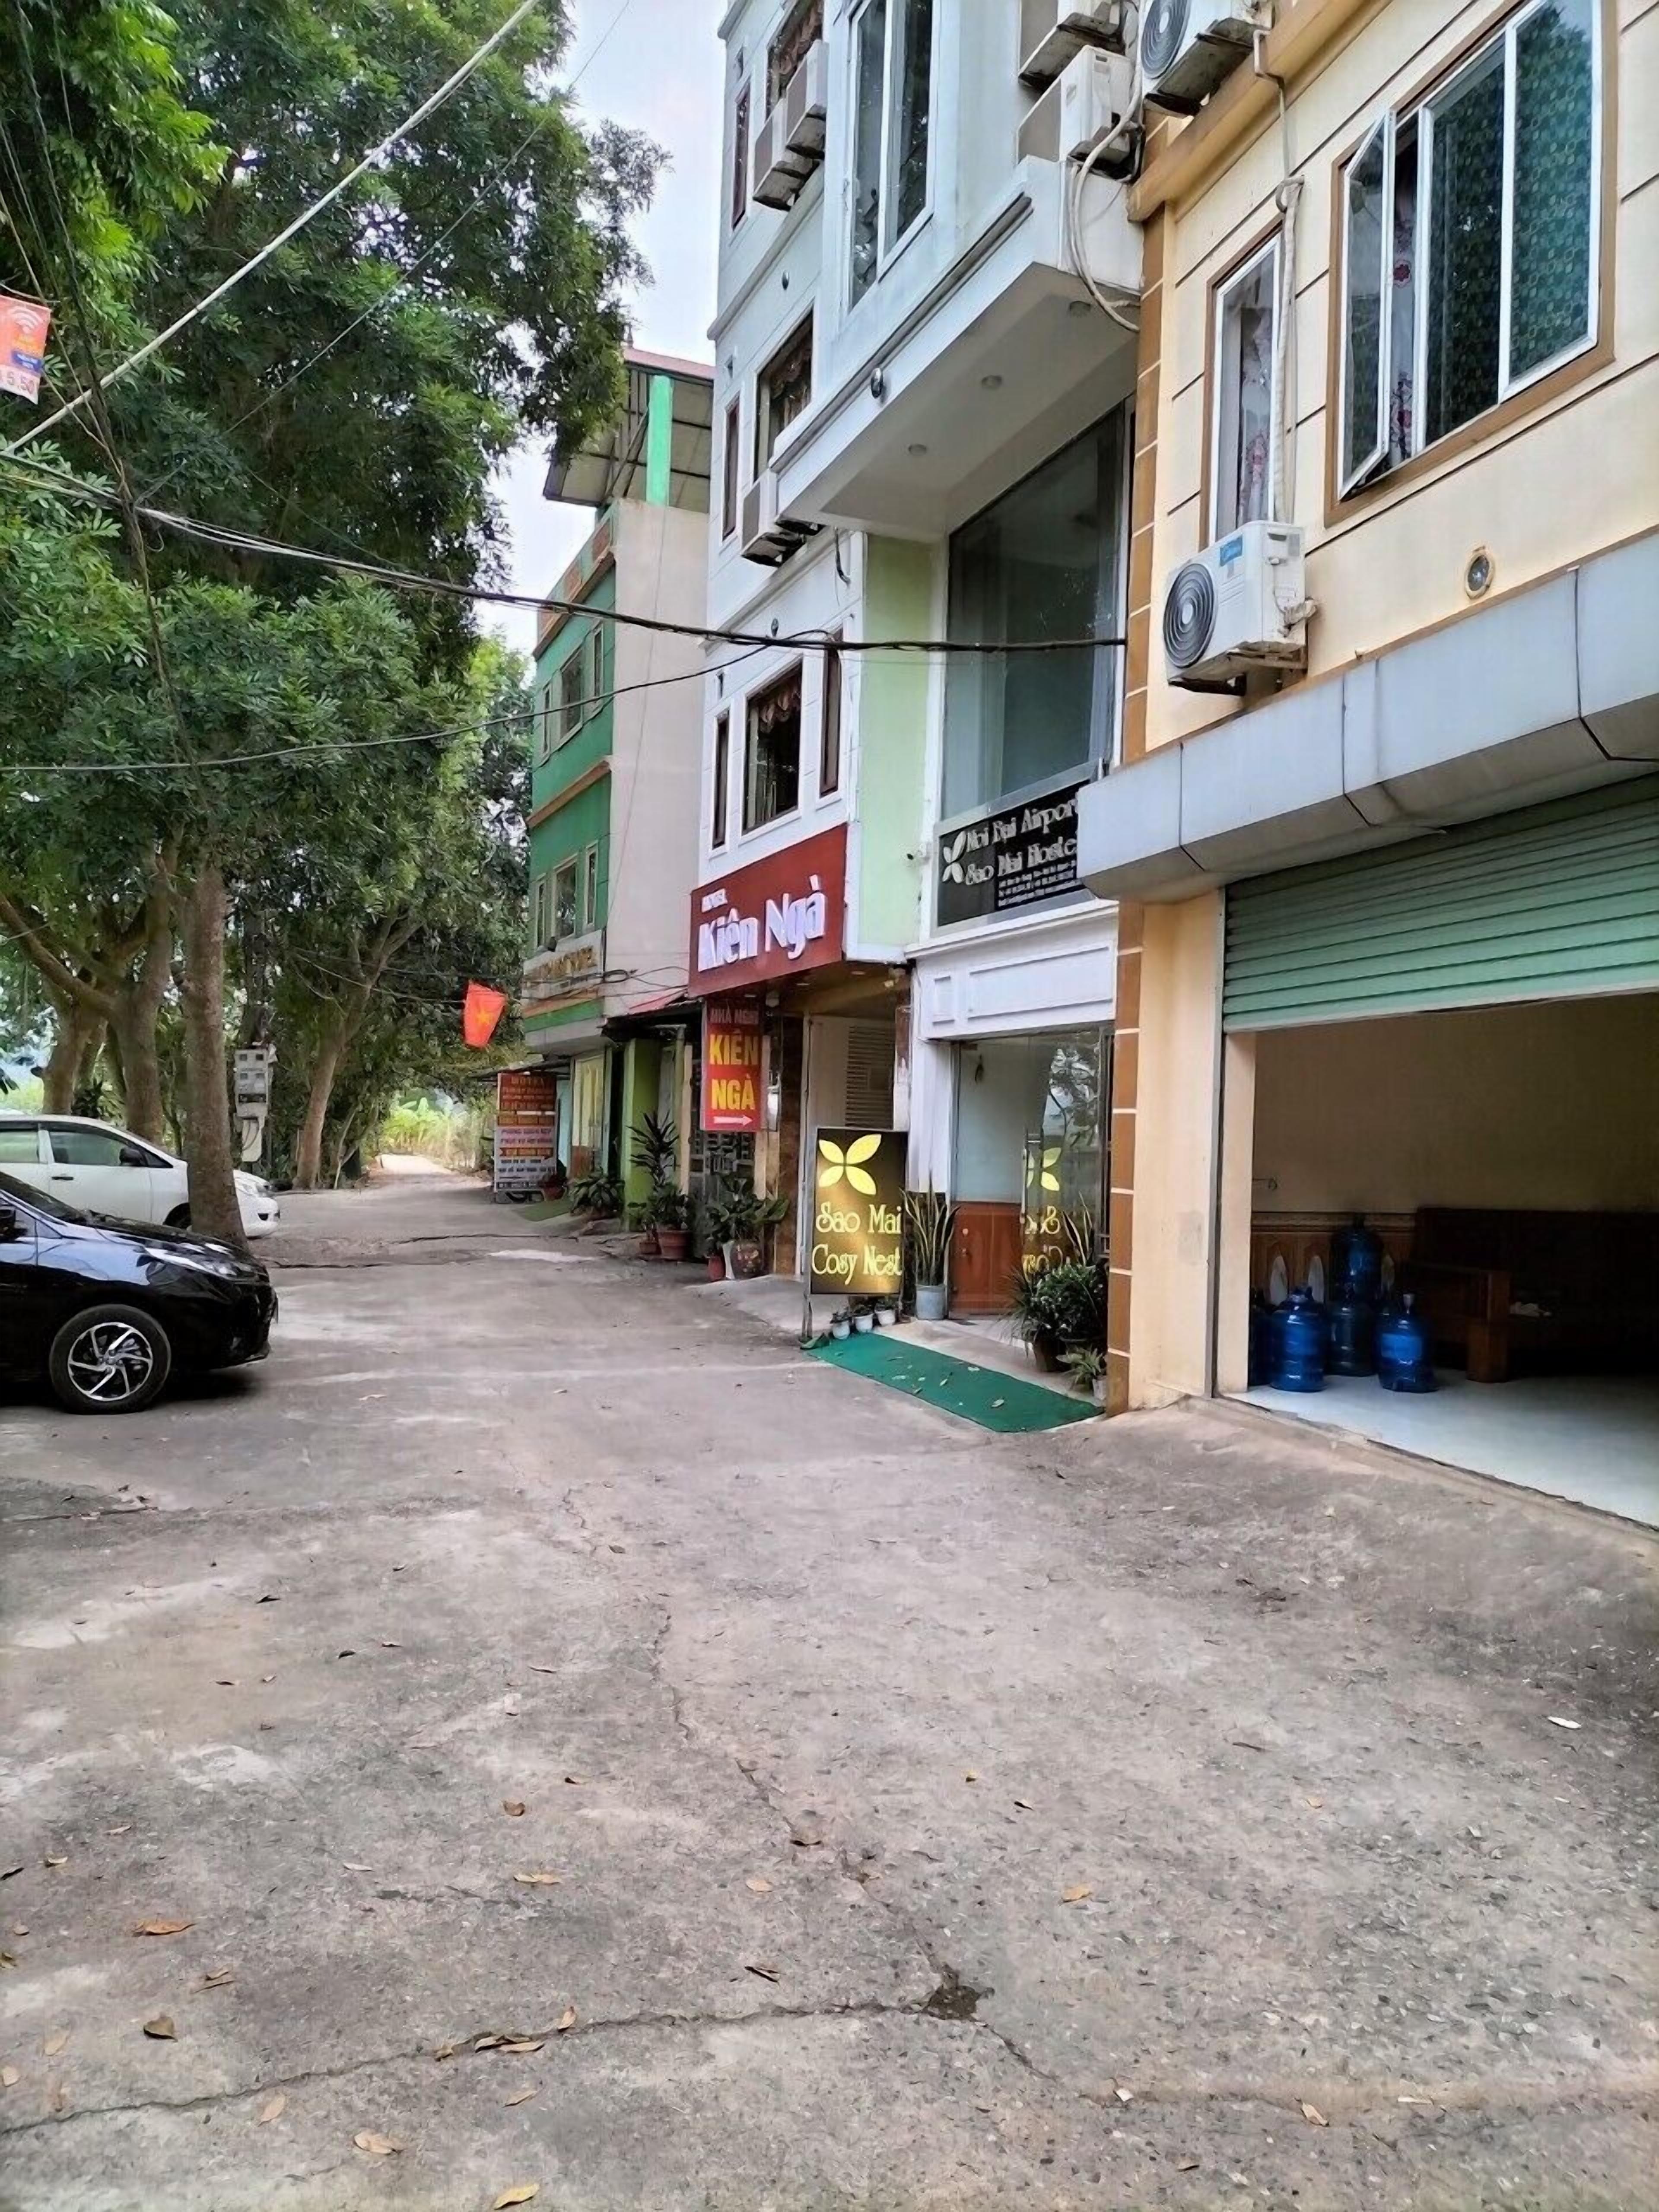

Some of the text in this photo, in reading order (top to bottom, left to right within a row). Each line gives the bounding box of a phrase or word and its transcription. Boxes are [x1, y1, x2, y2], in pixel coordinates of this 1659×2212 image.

[1021, 799, 1077, 834] Airpor
[966, 863, 994, 885] Sao
[1027, 836, 1077, 868] Hoste
[765, 874, 826, 960] Ngà
[710, 1028, 759, 1065] KIÊN
[711, 1073, 756, 1110] NGÀ
[815, 1201, 902, 1234] Sao Mai
[811, 1243, 903, 1285] Cosy Nest
